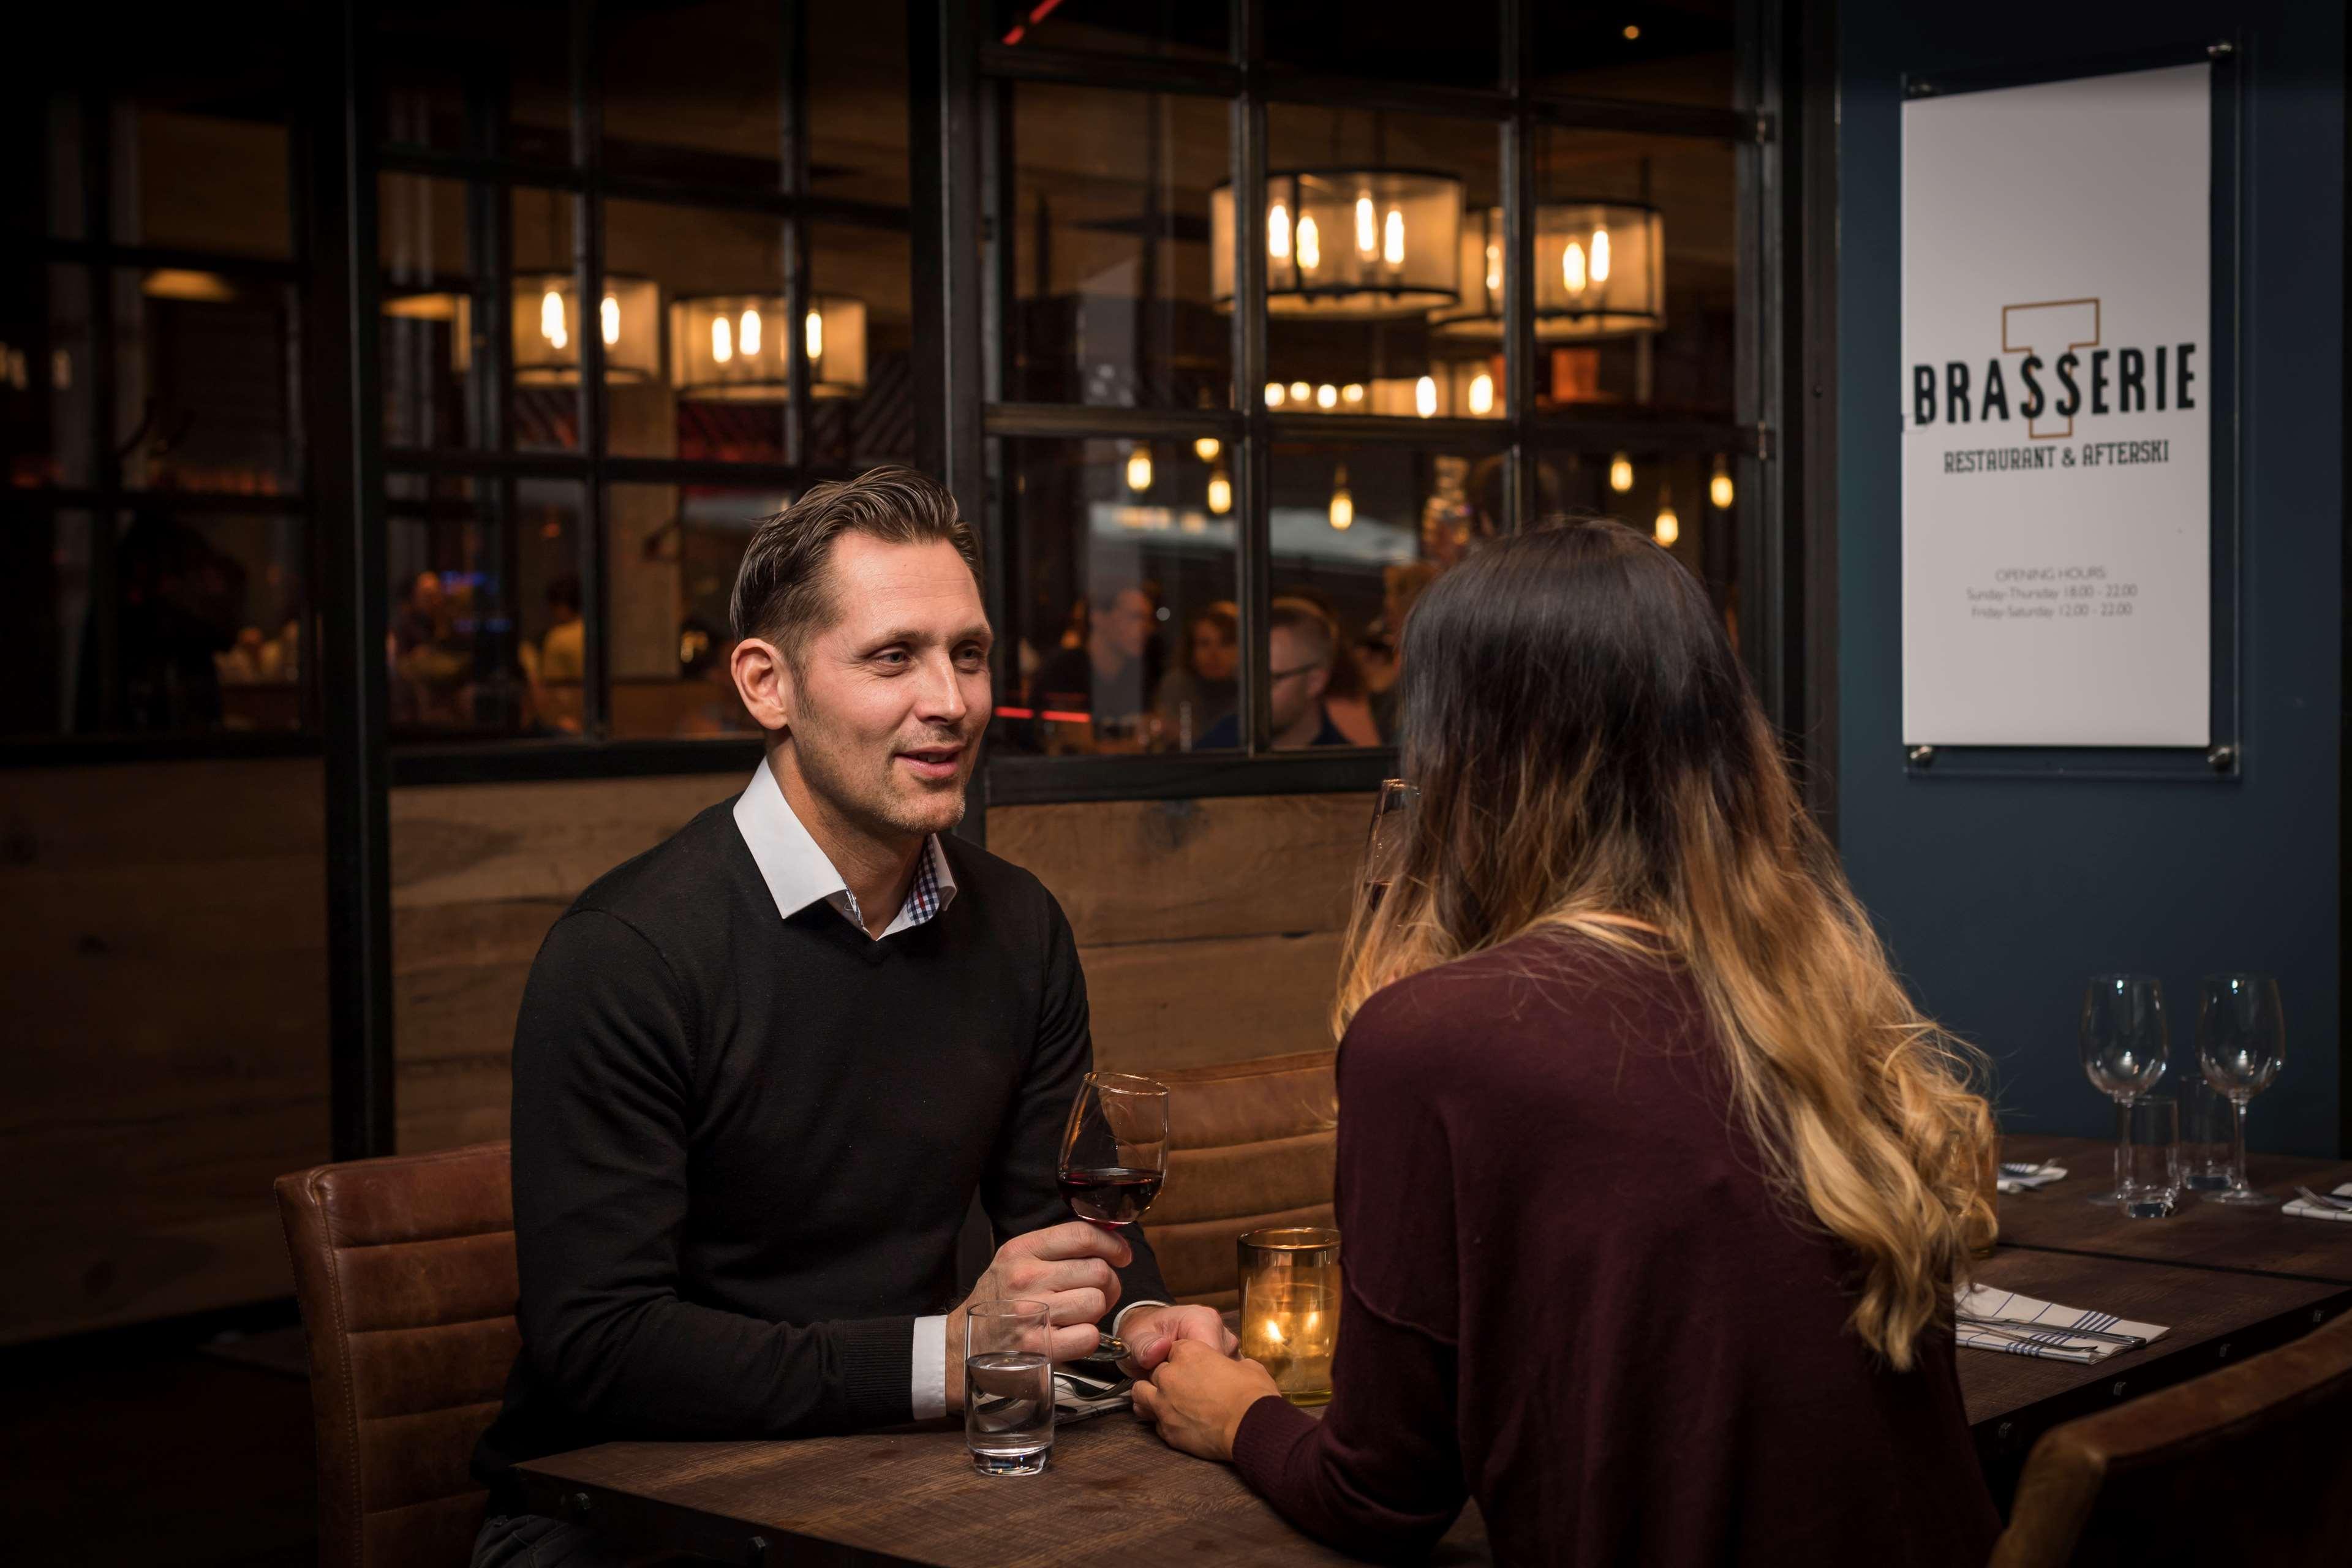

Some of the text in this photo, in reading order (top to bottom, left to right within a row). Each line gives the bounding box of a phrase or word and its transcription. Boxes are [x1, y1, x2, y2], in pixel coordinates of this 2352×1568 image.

[1913, 343, 2196, 425] BRASSERIE
[1944, 440, 2169, 473] RESTAURANT & AFTERSKI
[1995, 565, 2106, 582] OPENING HOURS
